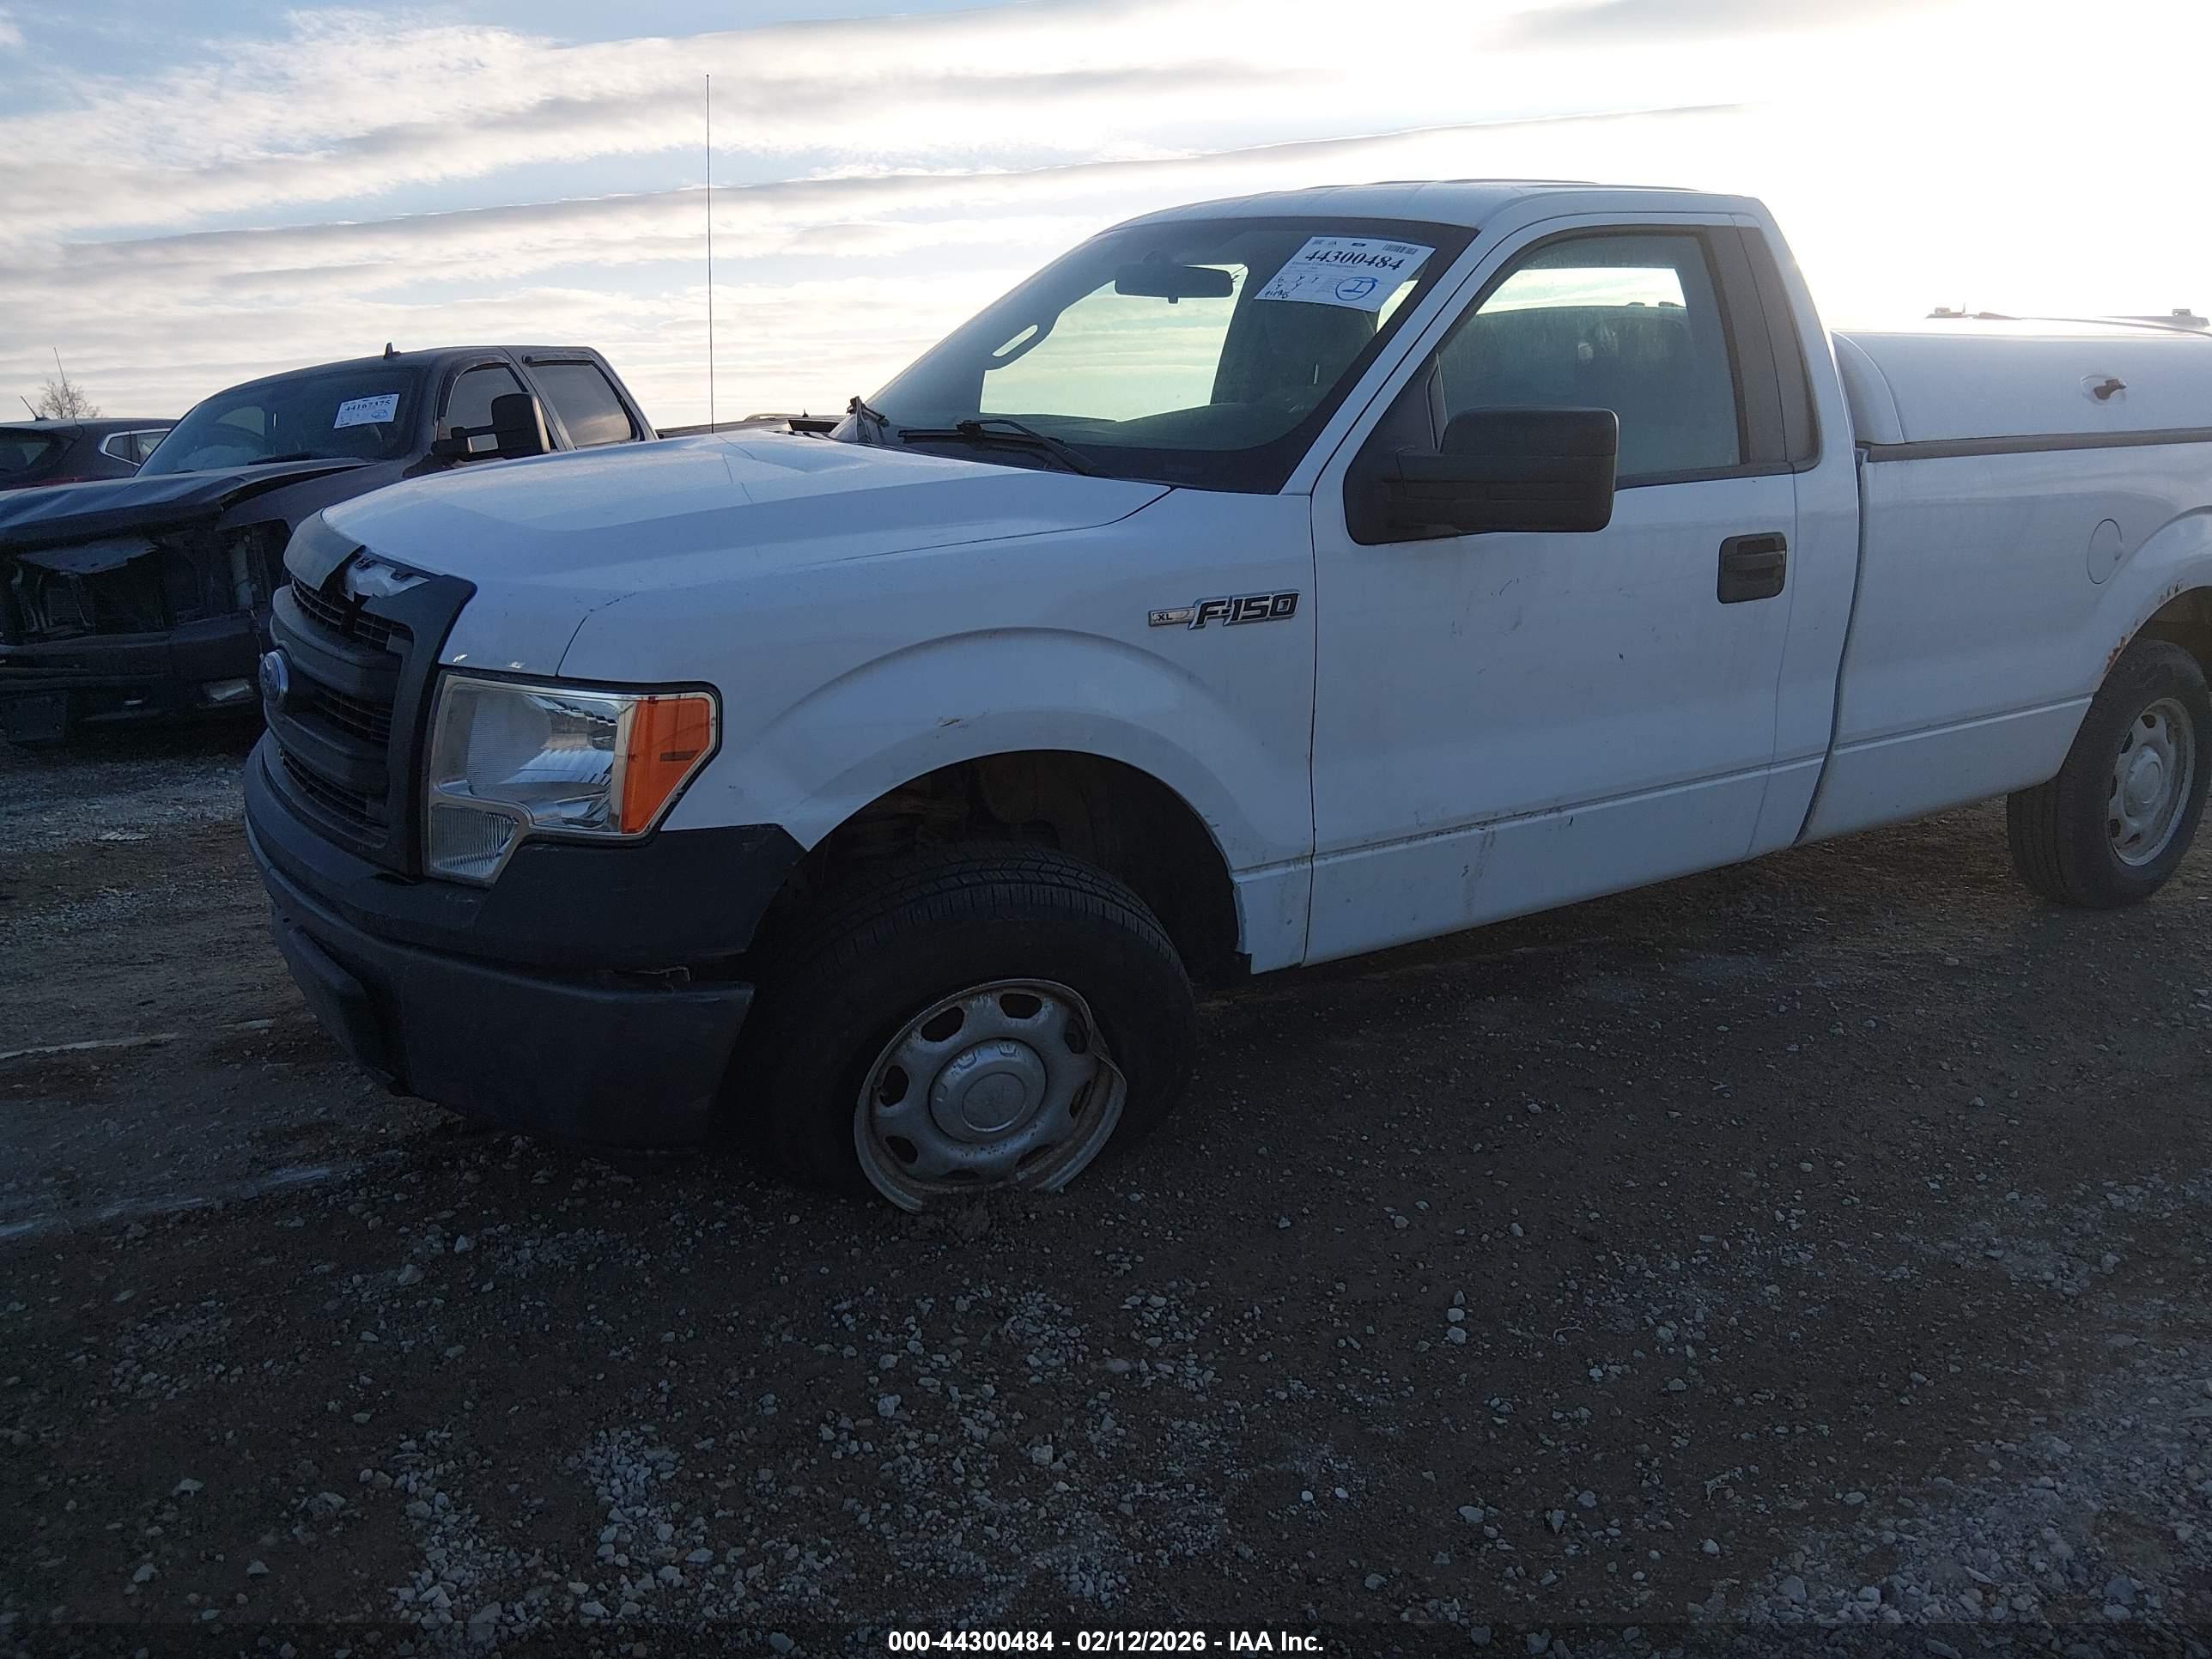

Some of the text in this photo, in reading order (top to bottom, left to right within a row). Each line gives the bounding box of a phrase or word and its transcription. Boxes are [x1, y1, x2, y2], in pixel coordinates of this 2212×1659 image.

[1304, 249, 1405, 270] 44300484
[1158, 591, 1299, 629] XL F-150
